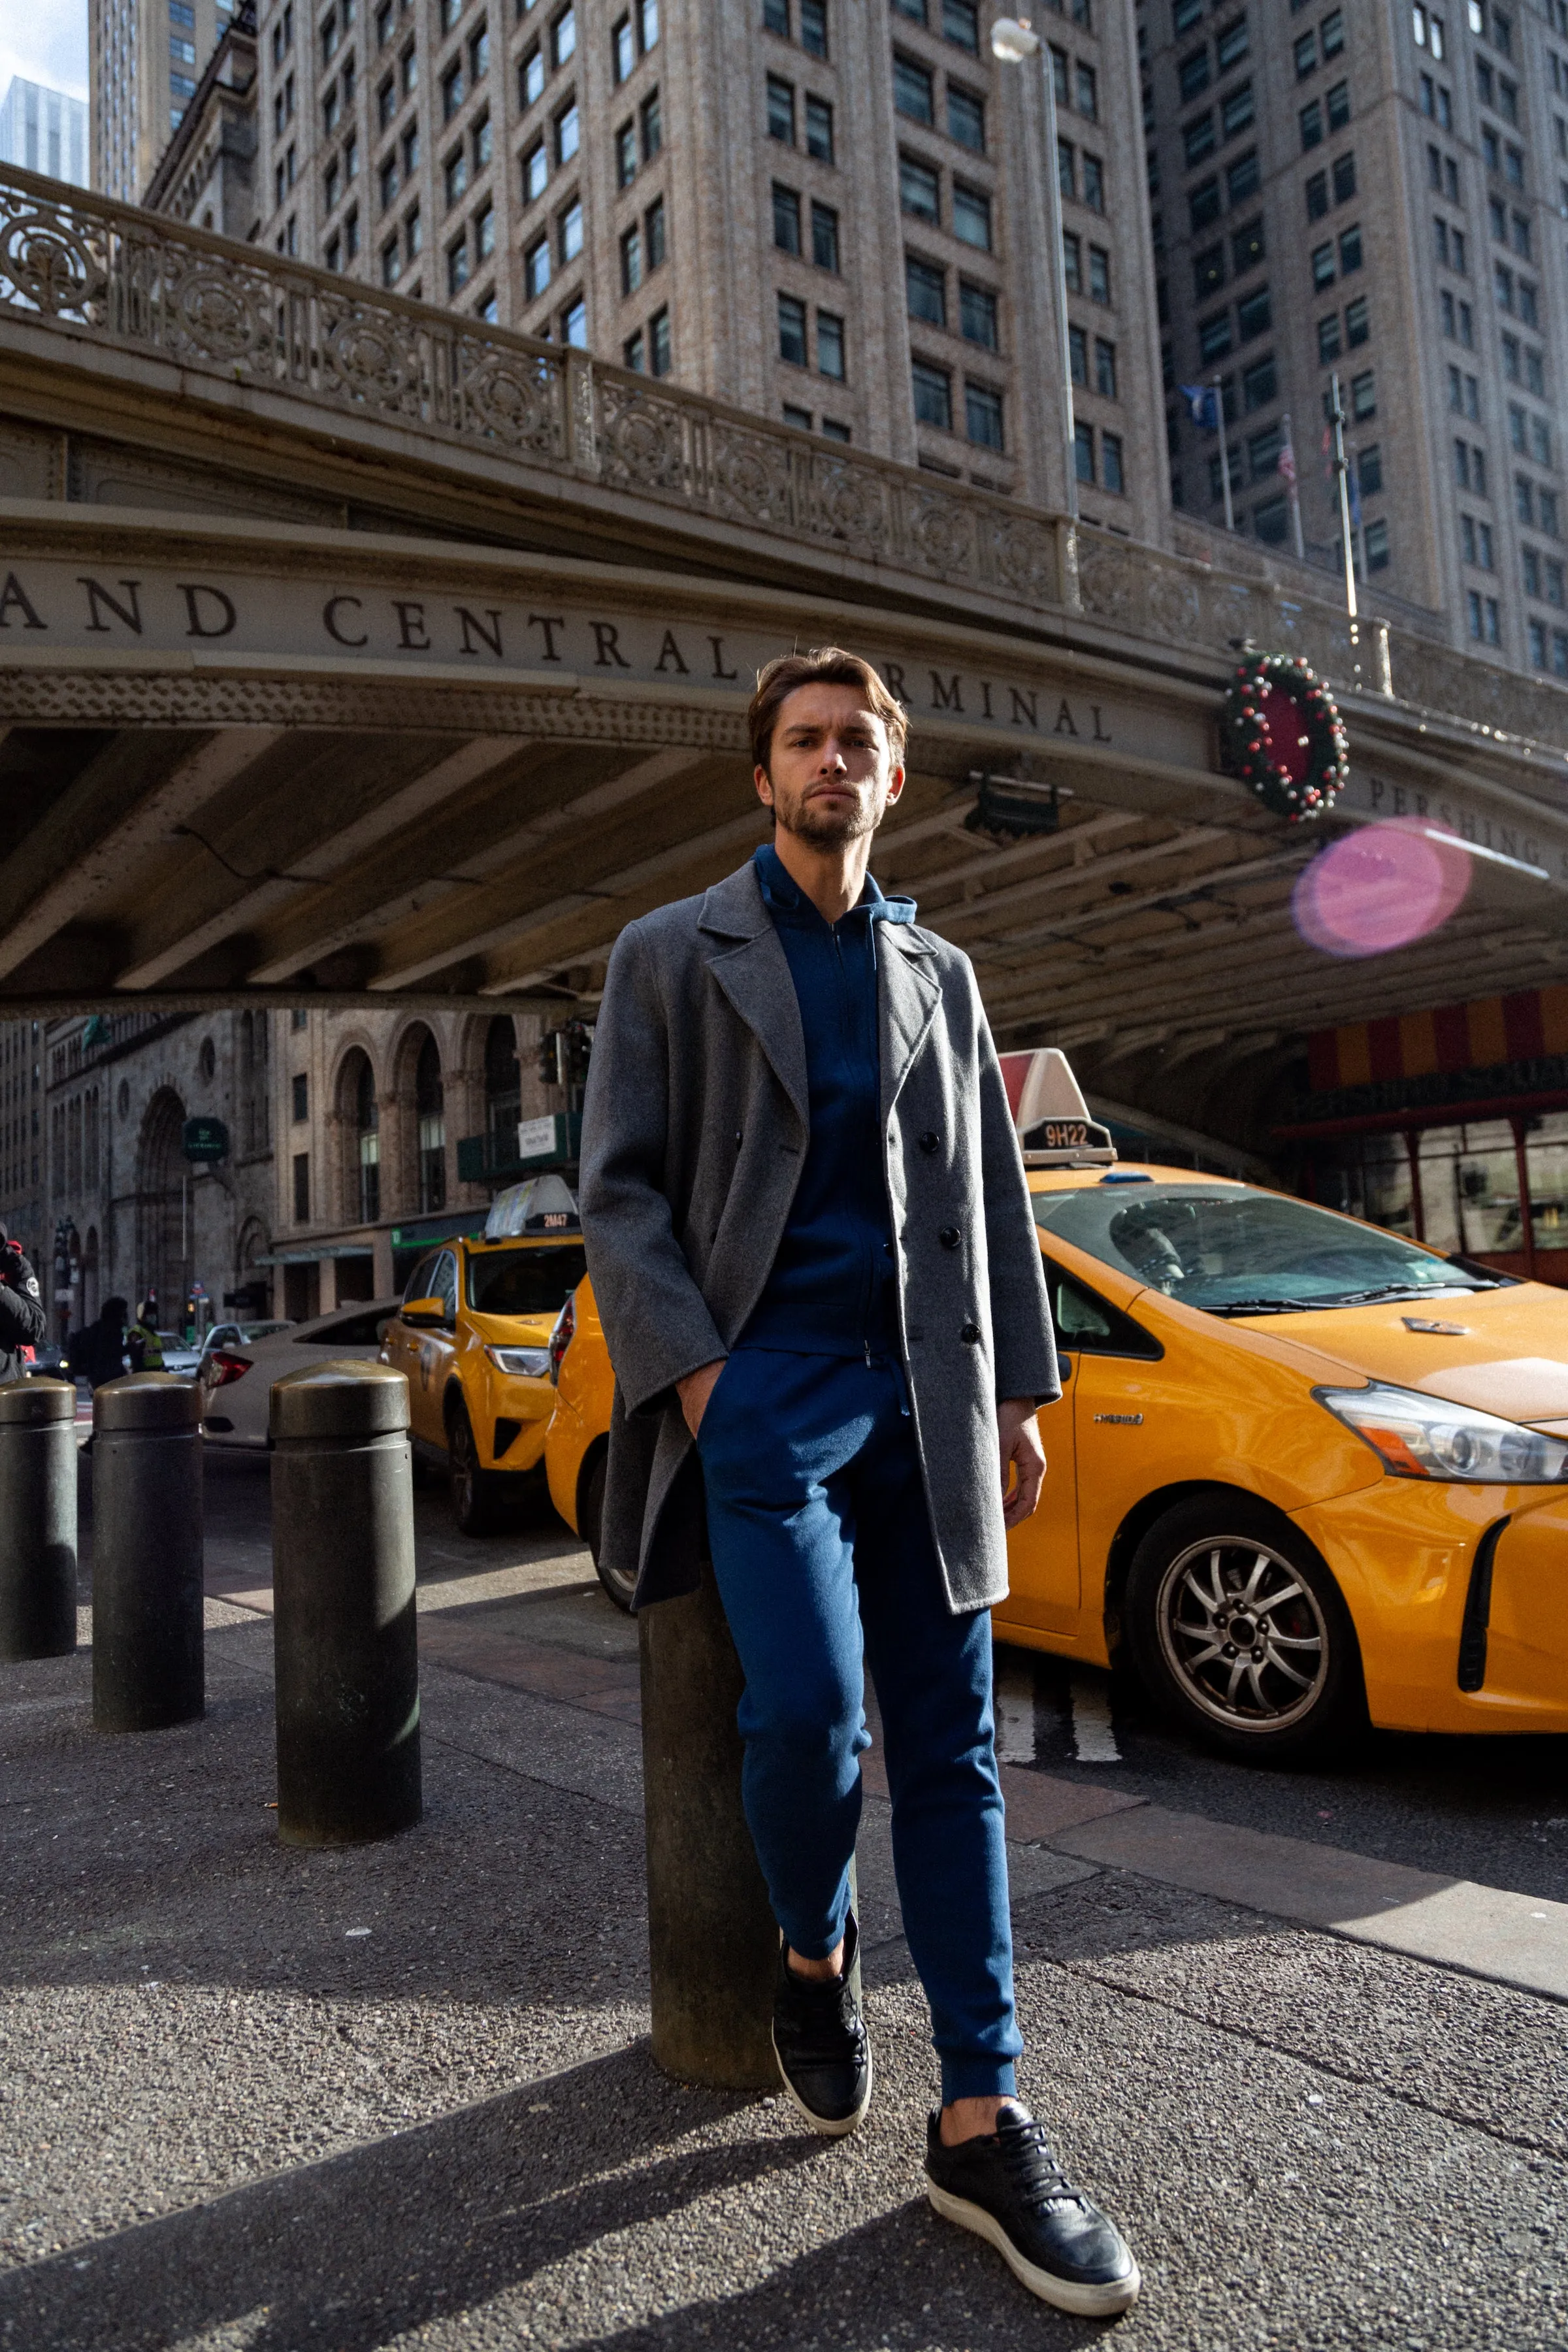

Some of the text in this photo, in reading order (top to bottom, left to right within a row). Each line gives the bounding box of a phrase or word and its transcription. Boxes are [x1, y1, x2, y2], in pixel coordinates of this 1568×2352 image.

[0, 570, 1113, 743] AND CENTRAL RMINAL
[1045, 1124, 1088, 1147] 9H22
